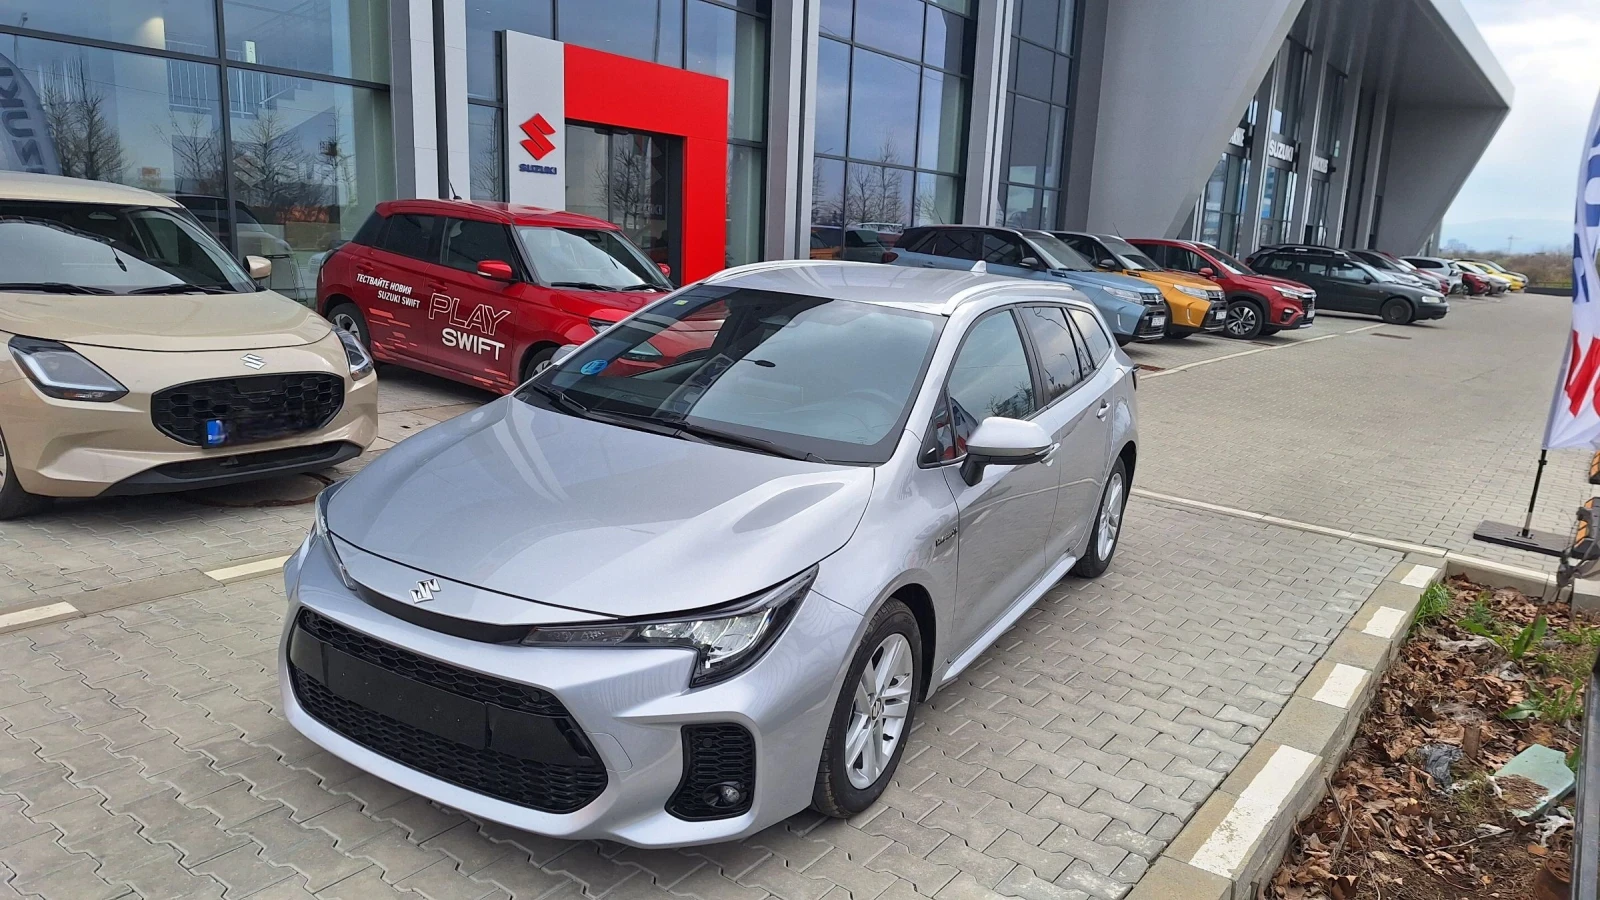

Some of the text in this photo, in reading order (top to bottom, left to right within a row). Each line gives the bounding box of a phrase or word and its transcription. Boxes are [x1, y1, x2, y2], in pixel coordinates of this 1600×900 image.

[1269, 140, 1293, 162] SUZUKI
[519, 163, 557, 175] SUZUKI
[356, 273, 411, 294] ТЕСТВАЙТЕ НОВИЯ
[378, 290, 420, 308] SUZUKI SWIFT
[428, 292, 512, 336] PLAY
[441, 327, 505, 361] SWIFT
